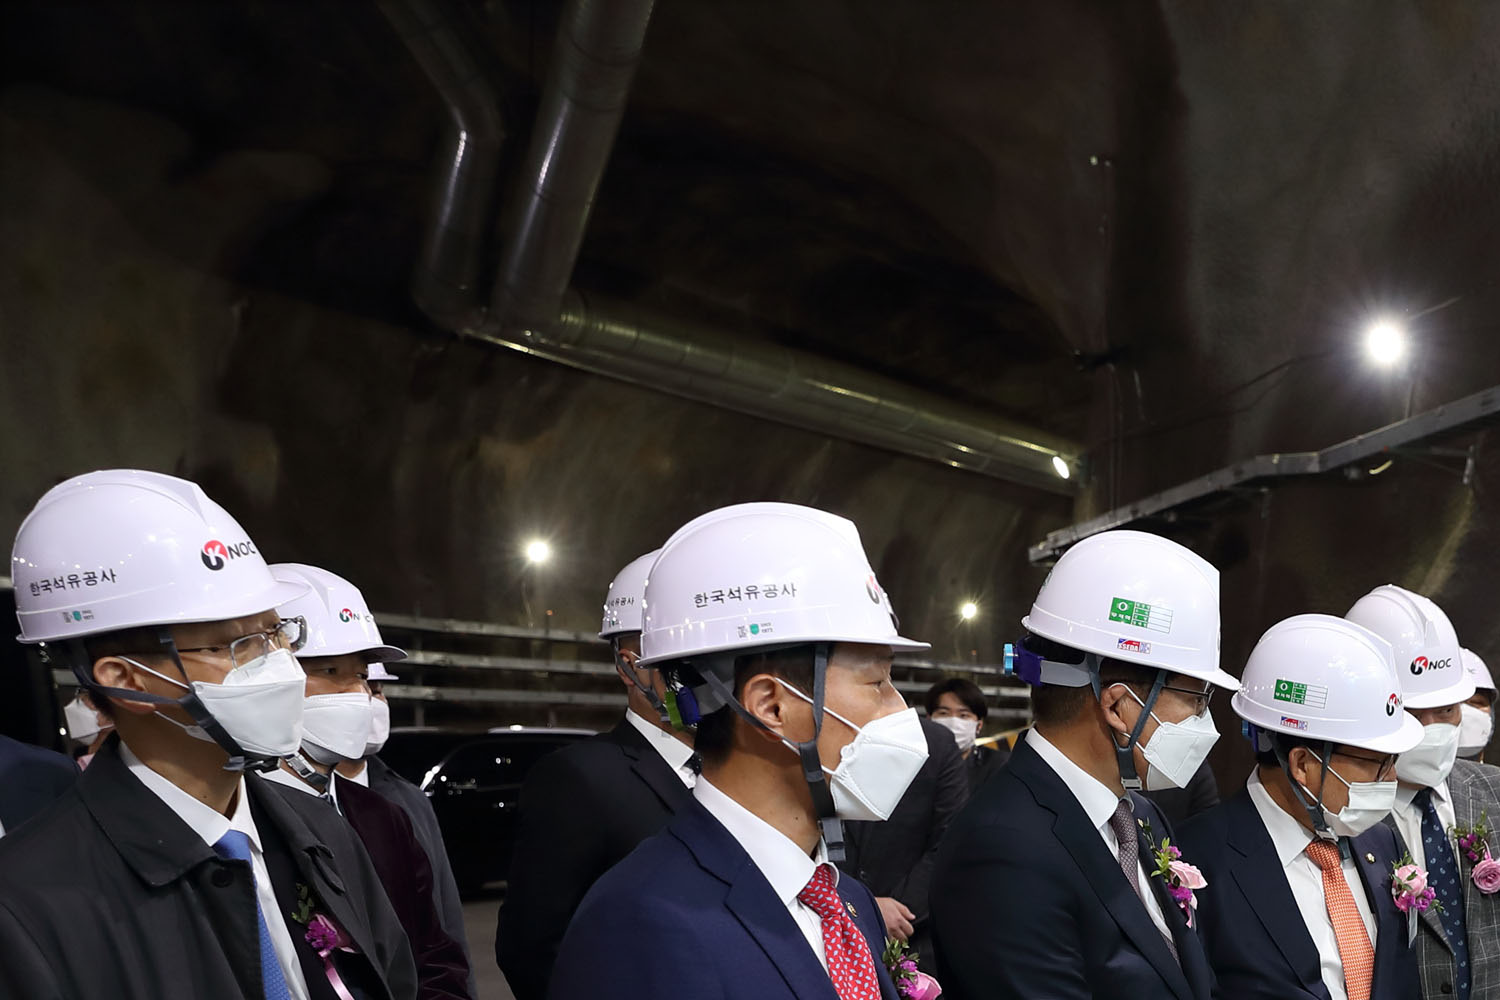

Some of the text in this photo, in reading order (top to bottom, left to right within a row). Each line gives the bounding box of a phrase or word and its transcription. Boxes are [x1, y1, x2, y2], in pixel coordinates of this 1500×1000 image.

[201, 540, 256, 571] KNOC
[30, 568, 117, 597] 한국석유공사
[694, 582, 797, 608] 한국석유공사
[1410, 656, 1452, 675] KNOC
